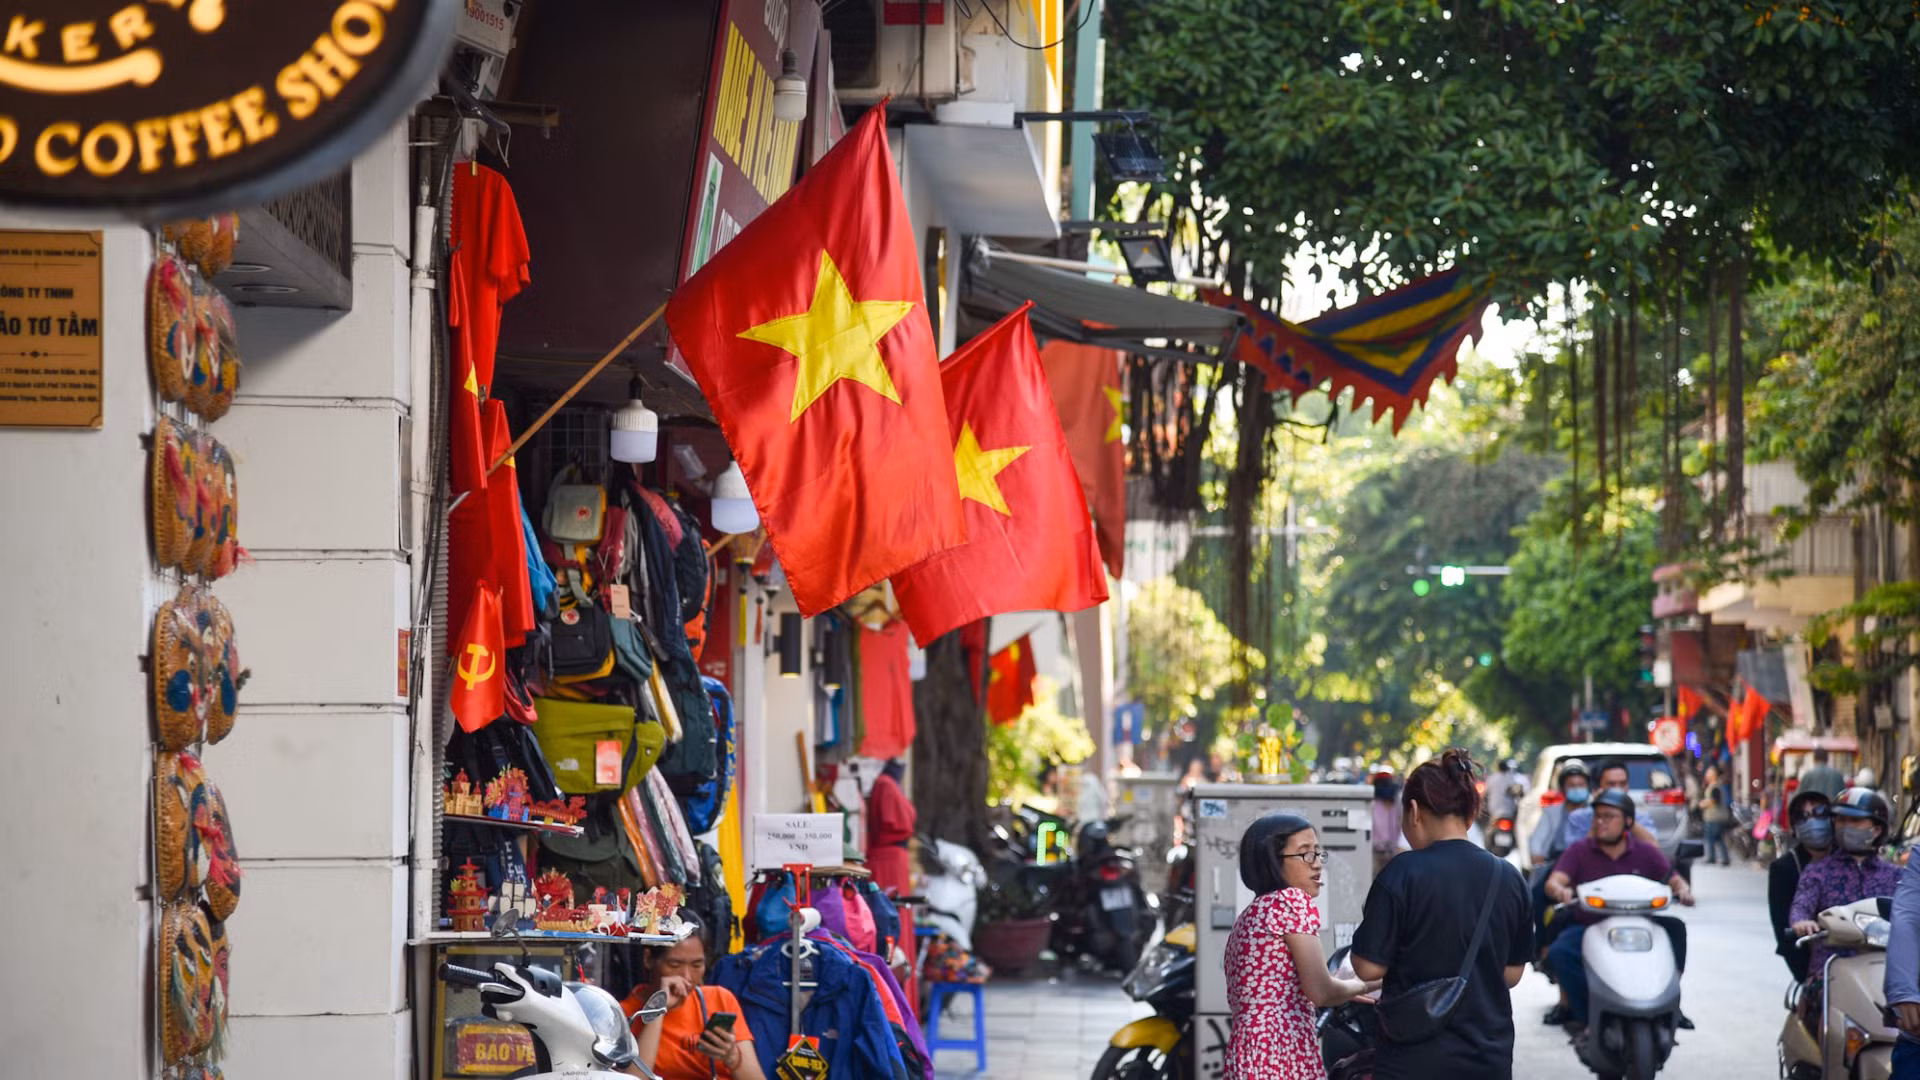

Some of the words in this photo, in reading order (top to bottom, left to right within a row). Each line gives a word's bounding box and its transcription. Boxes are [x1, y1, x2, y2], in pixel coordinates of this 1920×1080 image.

[4, 0, 186, 63] KER
[34, 85, 280, 177] COFFEE
[276, 0, 398, 120] SHO
[713, 20, 755, 166] MADE
[741, 60, 766, 180] IN
[28, 287, 40, 298] TY
